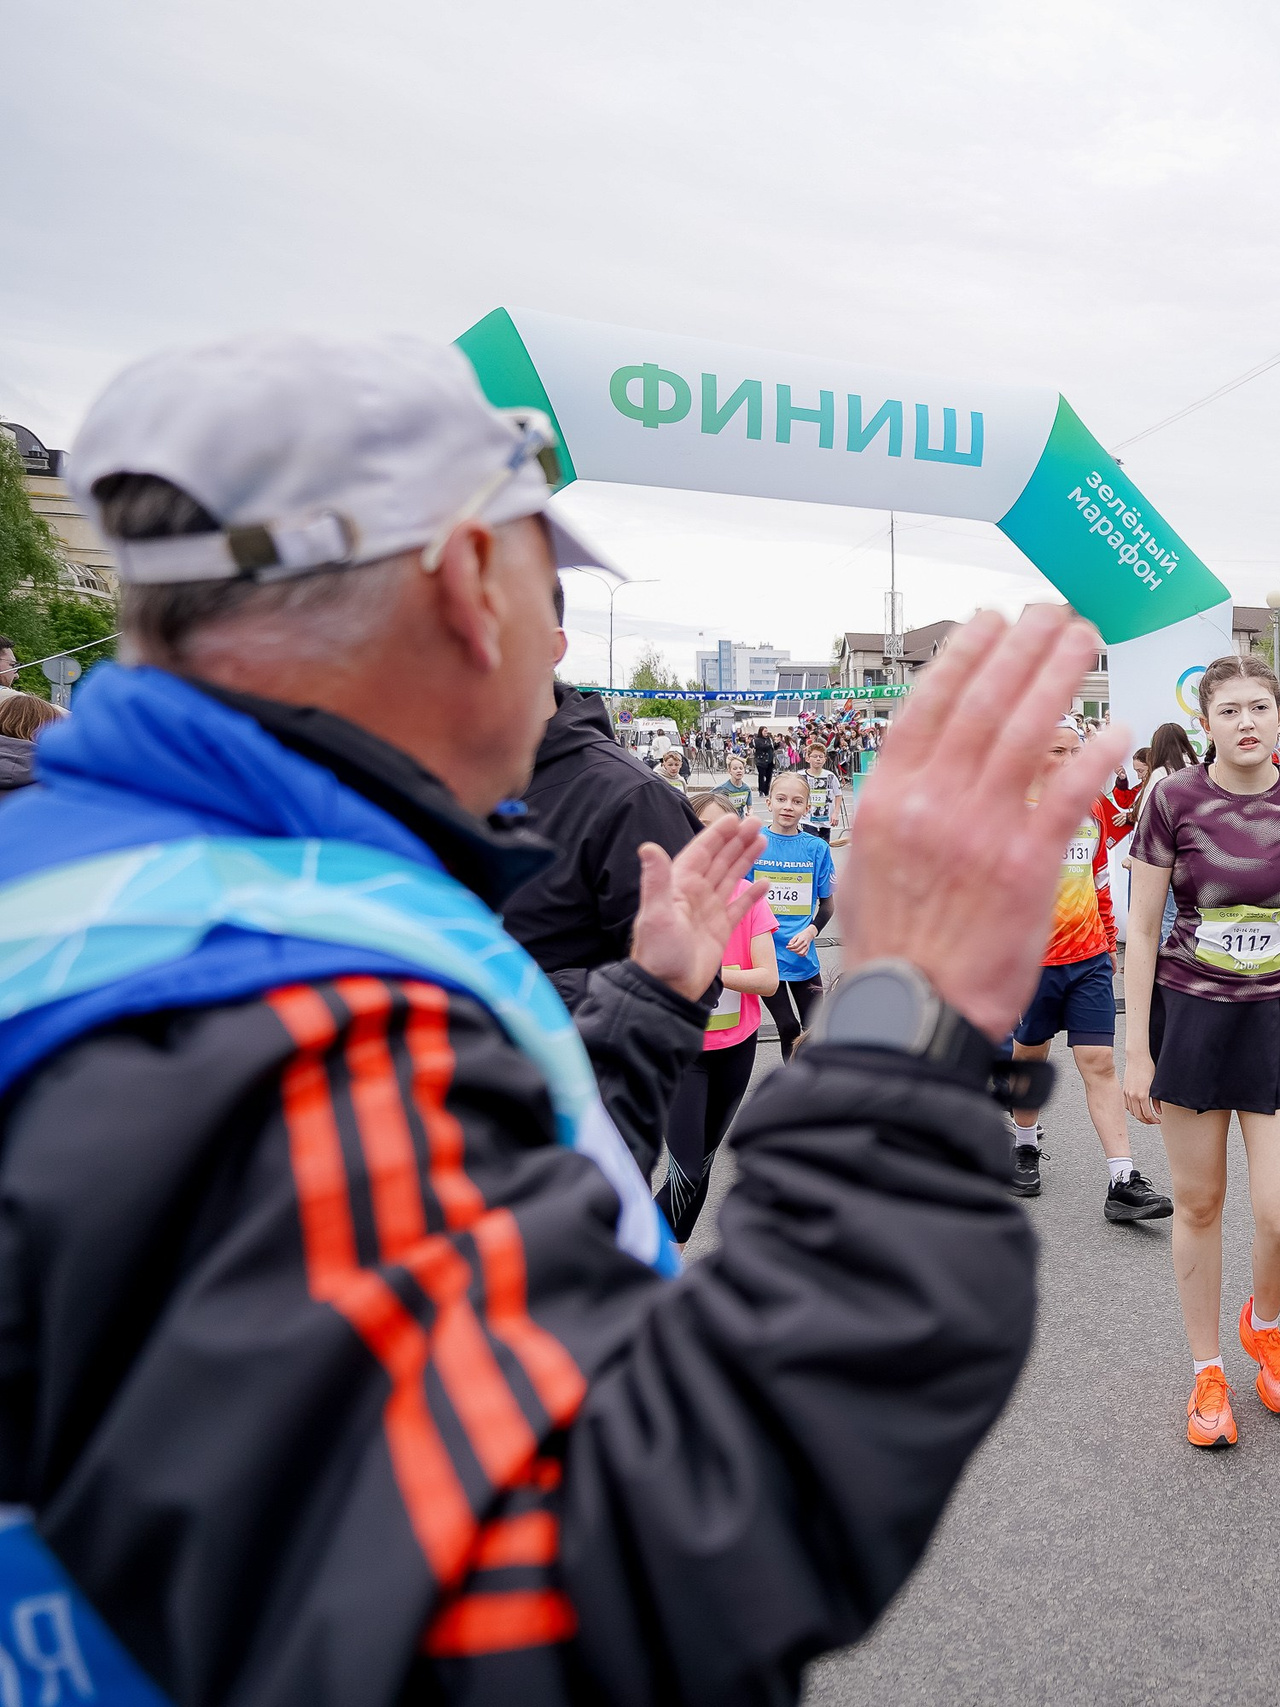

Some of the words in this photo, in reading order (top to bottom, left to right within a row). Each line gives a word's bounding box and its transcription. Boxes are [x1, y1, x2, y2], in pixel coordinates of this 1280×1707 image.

[609, 363, 984, 468] ФИНИШ
[1086, 471, 1180, 575] зелёный
[1067, 486, 1163, 592] марафон
[593, 690, 644, 699] ТАРТ
[654, 692, 706, 701] СТАРТ
[715, 692, 765, 701] СТАРТ
[774, 691, 822, 701] СТАРТ
[830, 688, 876, 700] СТАРТ
[883, 685, 917, 698] СТАР
[783, 860, 814, 869] ДЕЛАЙ!
[768, 890, 799, 901] 3148
[1222, 934, 1271, 952] 3117
